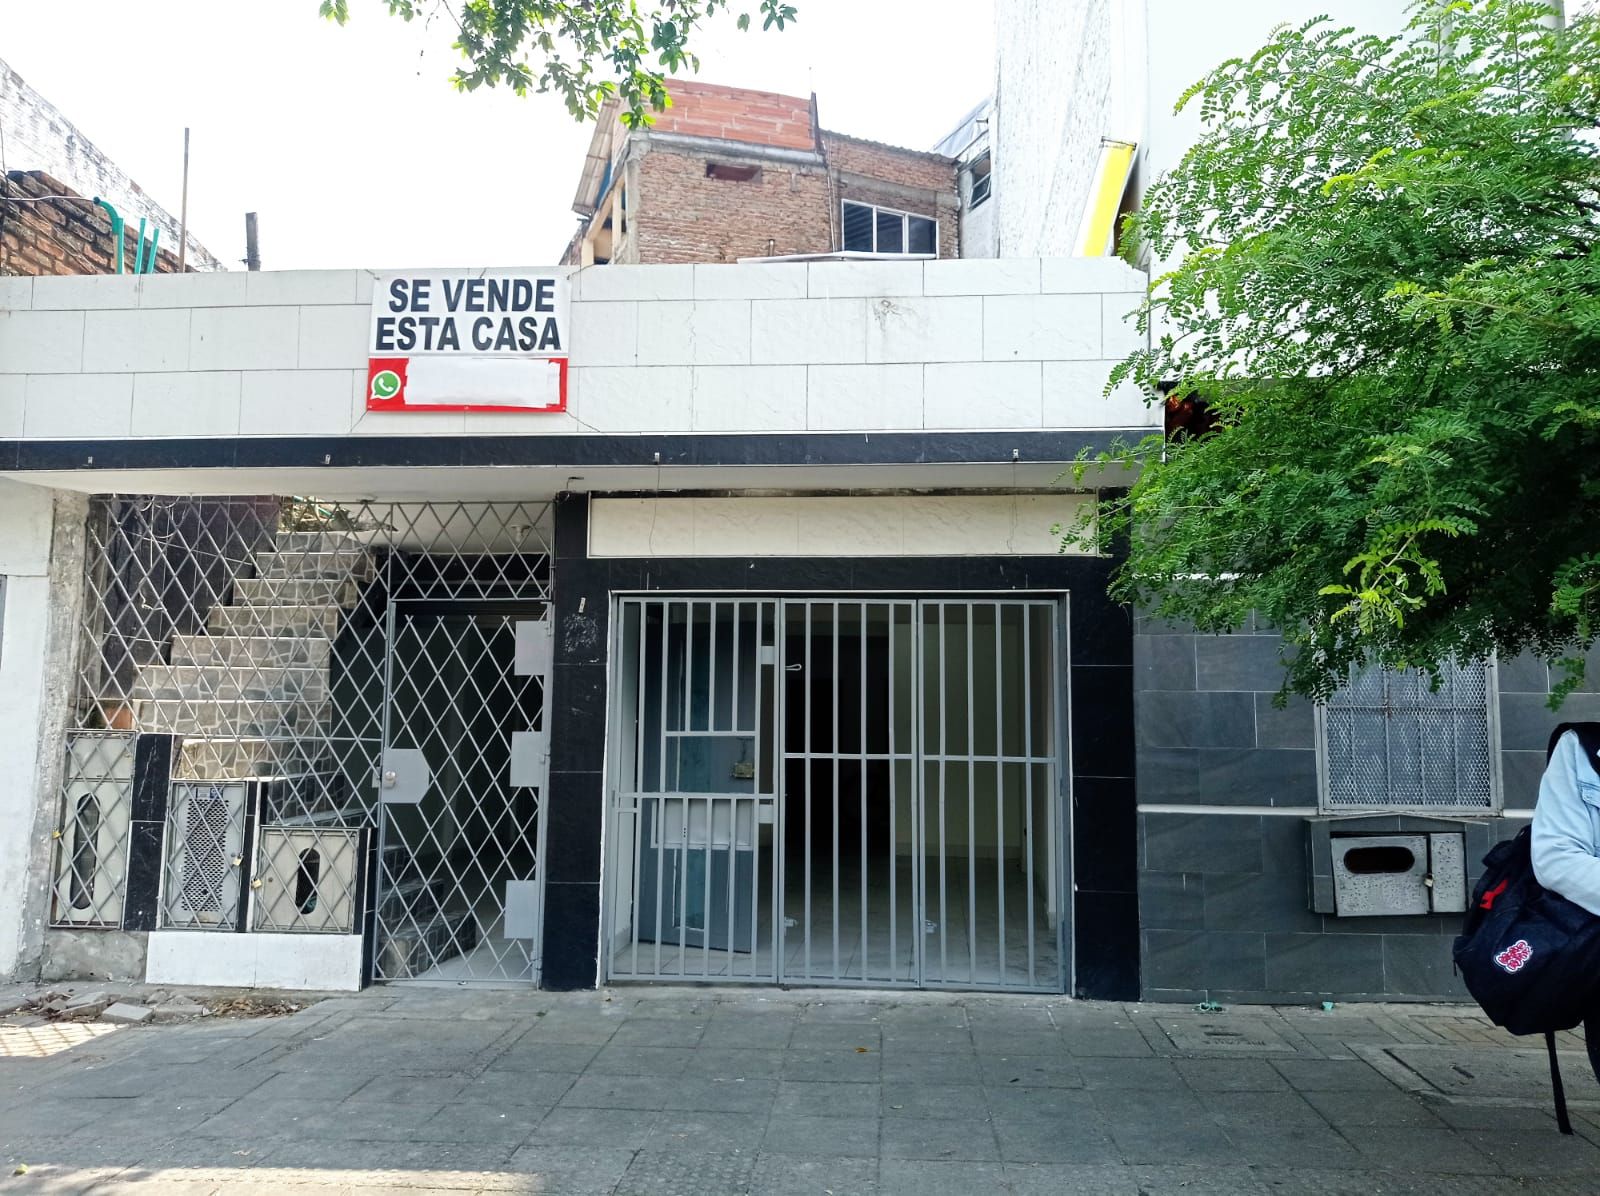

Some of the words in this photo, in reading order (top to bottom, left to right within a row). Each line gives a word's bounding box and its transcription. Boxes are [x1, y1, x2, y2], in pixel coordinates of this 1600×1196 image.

[388, 279, 431, 313] SE
[442, 279, 555, 312] VENDE
[375, 317, 460, 350] ESTA
[471, 316, 561, 351] CASA
